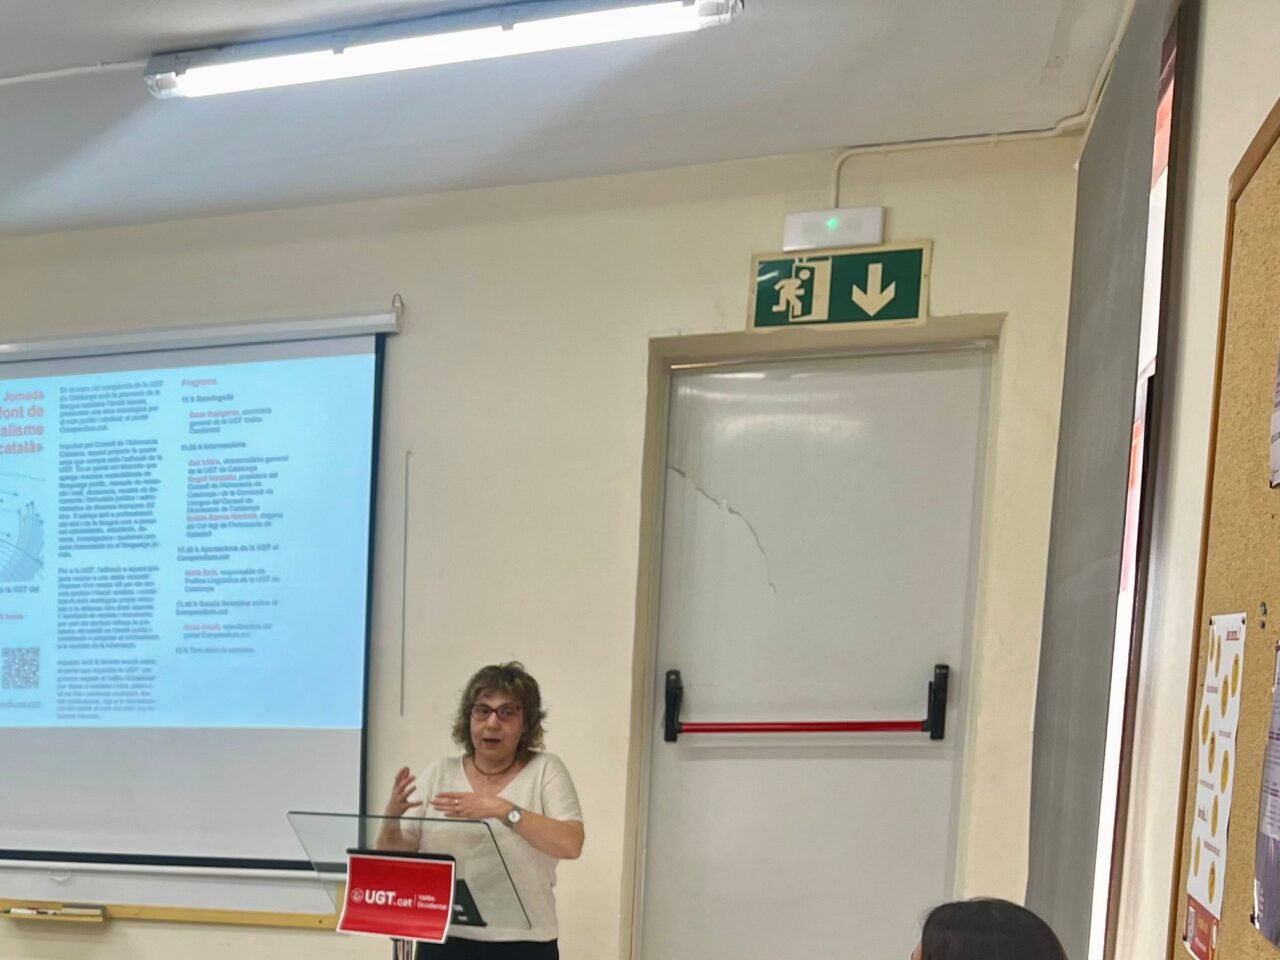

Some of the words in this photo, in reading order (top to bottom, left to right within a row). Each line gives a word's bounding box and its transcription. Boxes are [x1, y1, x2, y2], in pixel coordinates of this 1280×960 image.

[3, 391, 45, 402] Jornada
[27, 405, 45, 418] de
[365, 889, 412, 907] UGT.cat
